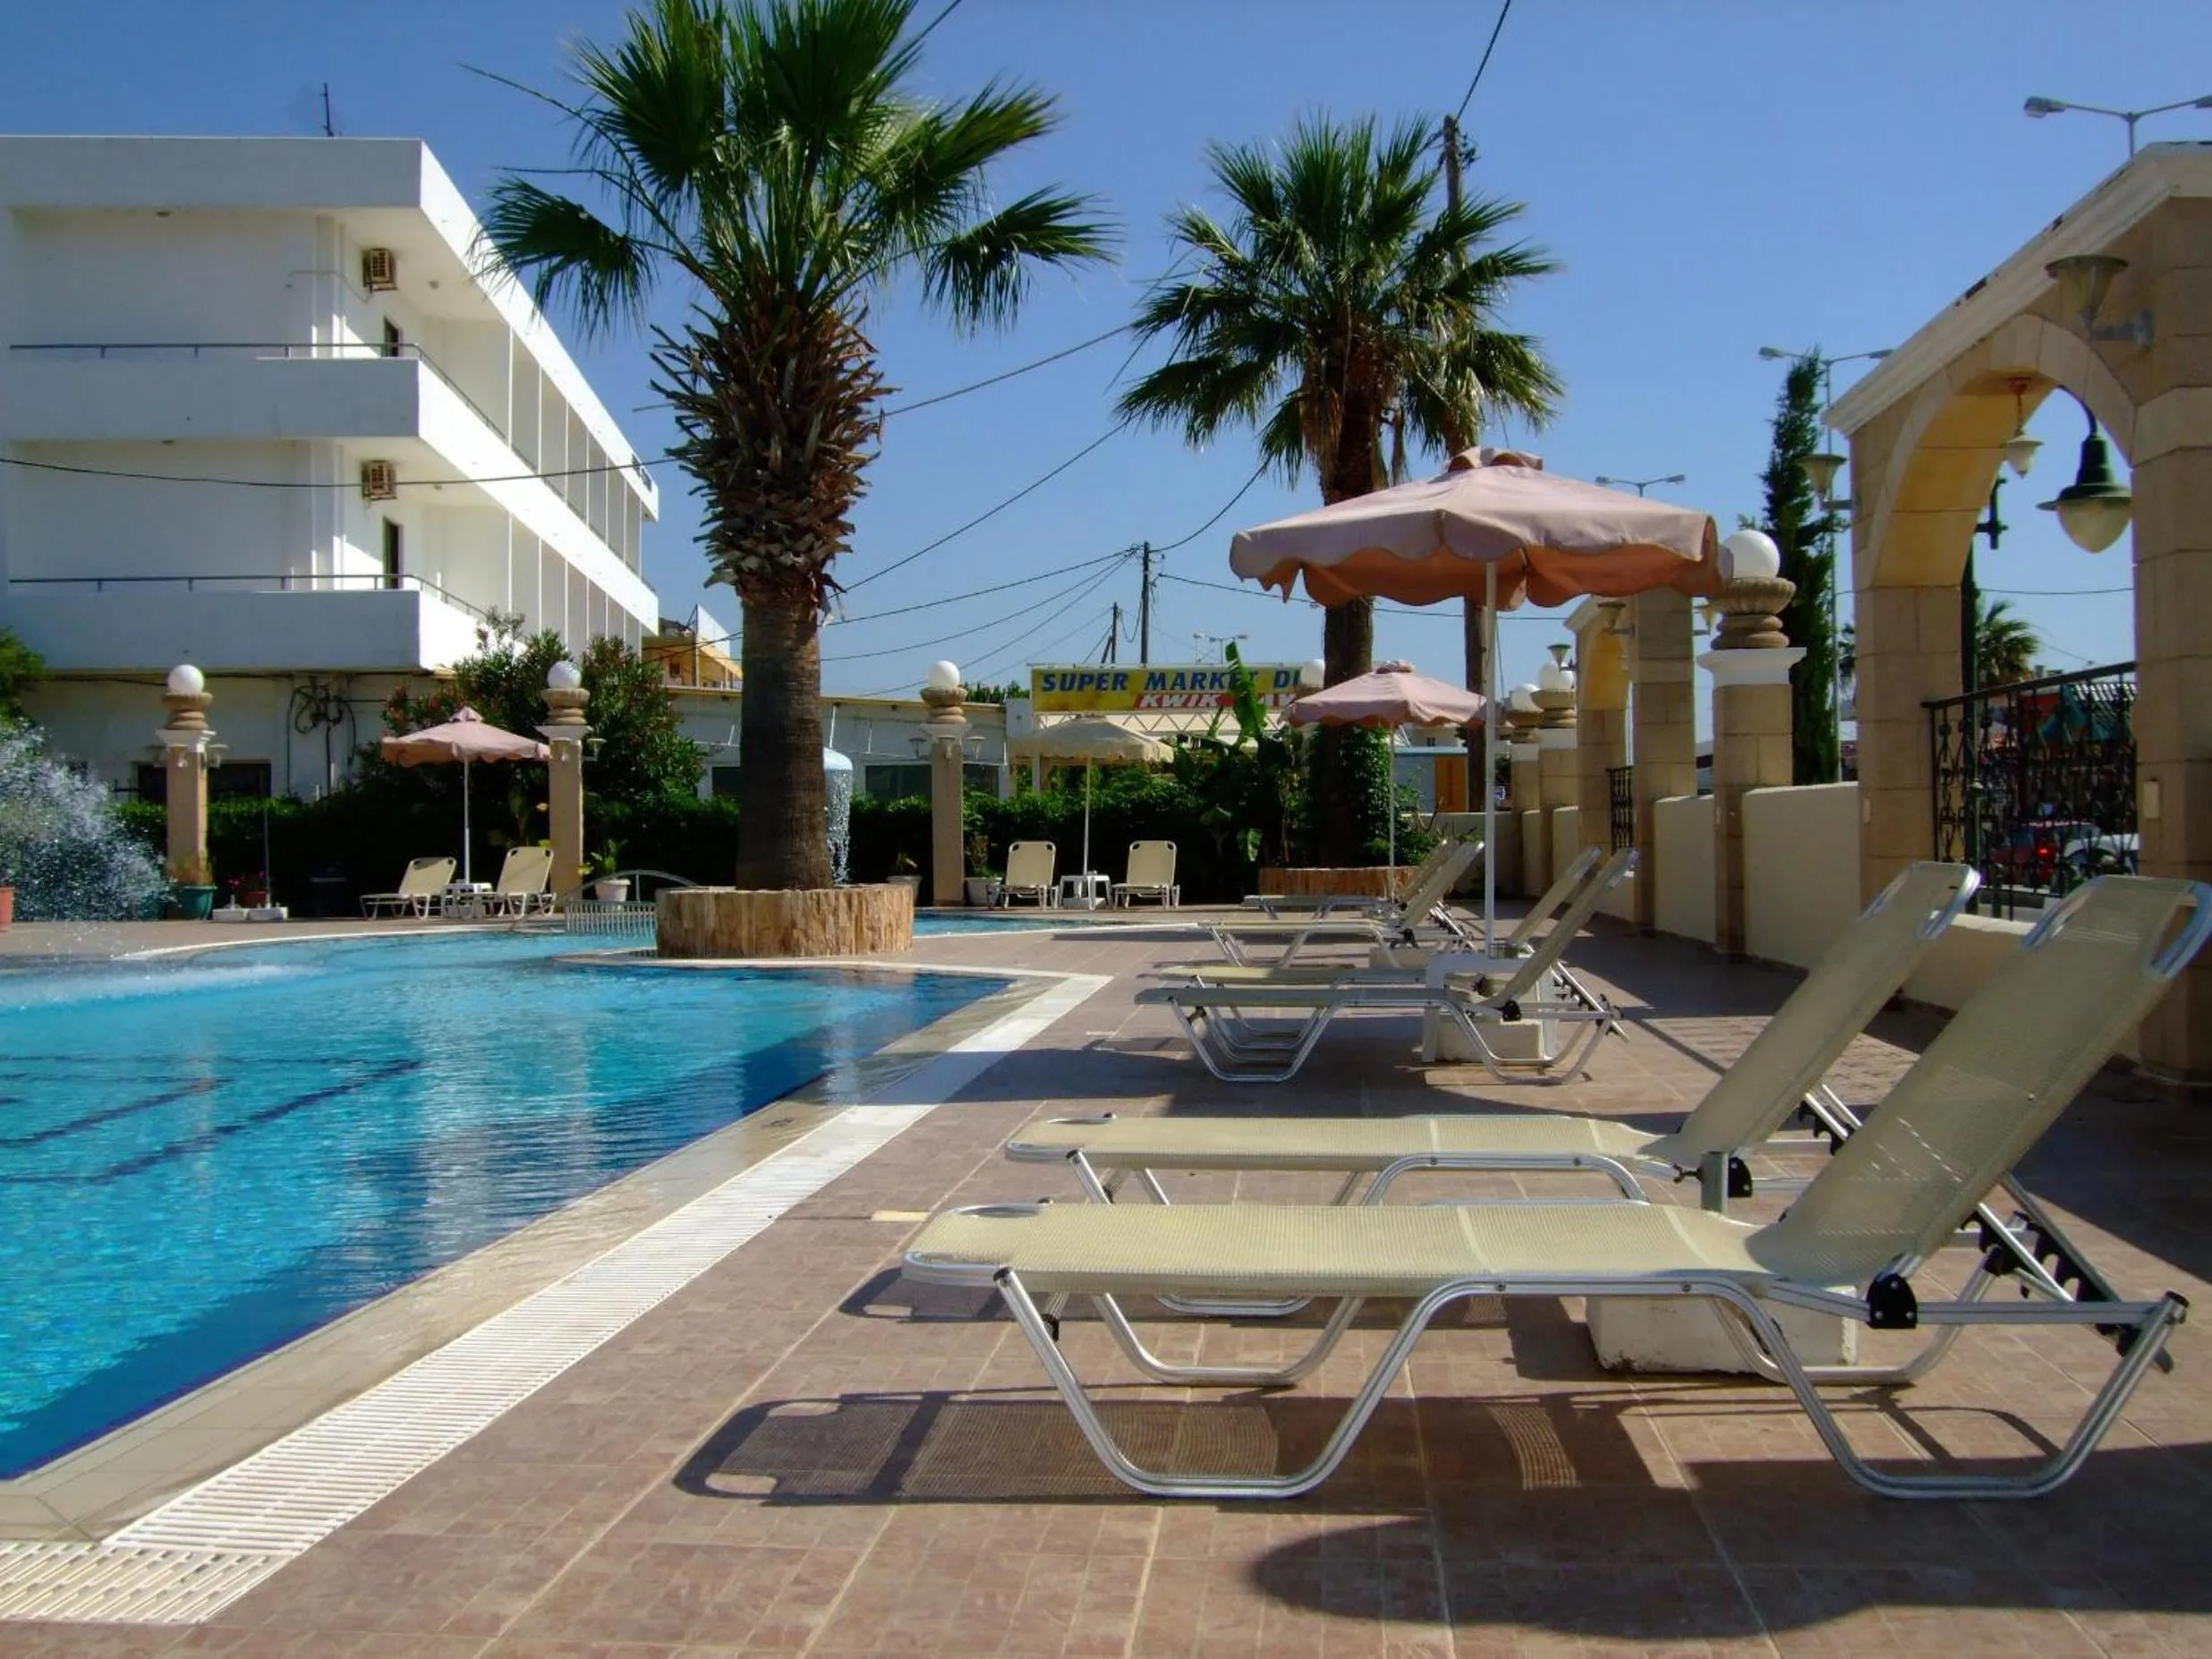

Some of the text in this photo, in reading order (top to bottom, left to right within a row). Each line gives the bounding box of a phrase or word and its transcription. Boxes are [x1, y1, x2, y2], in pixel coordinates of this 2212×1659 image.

[1042, 673, 1128, 692] SUPER
[1144, 671, 1258, 691] MARKE
[1139, 693, 1221, 708] KWIK
